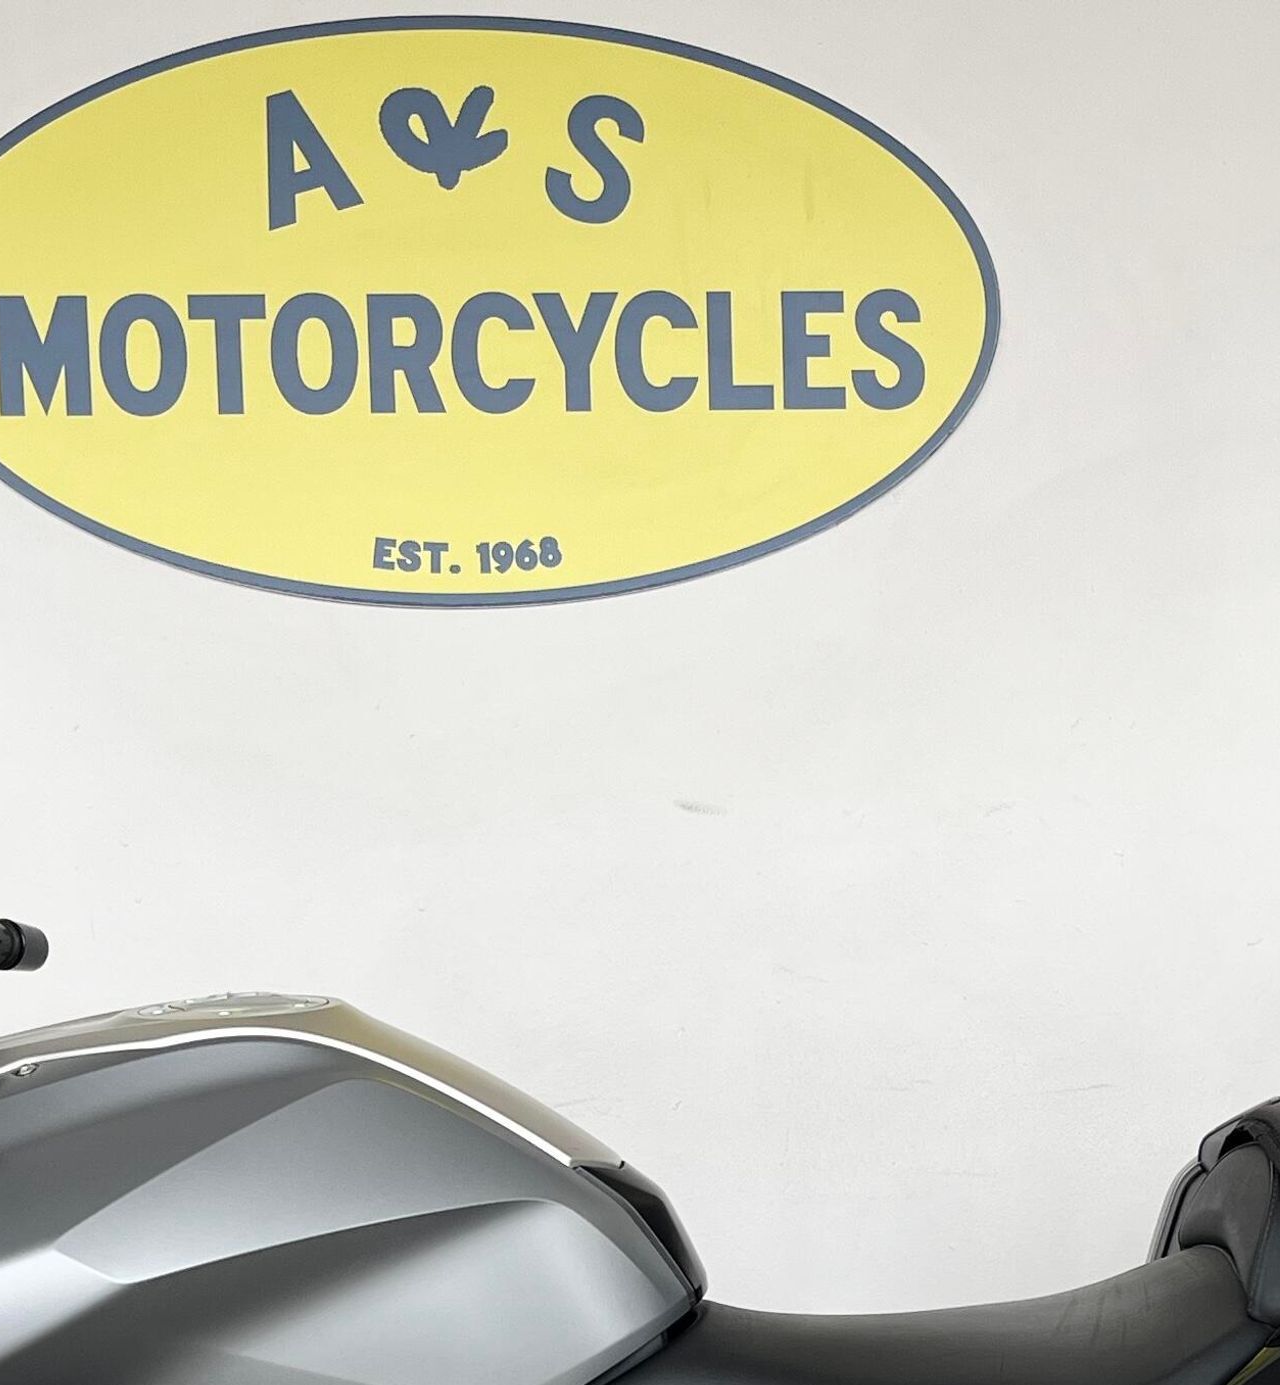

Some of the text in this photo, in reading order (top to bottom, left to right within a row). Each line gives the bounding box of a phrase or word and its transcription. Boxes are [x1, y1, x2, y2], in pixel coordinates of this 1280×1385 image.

[265, 89, 365, 232] A
[544, 94, 645, 225] S
[372, 535, 563, 575] EST. 1968
